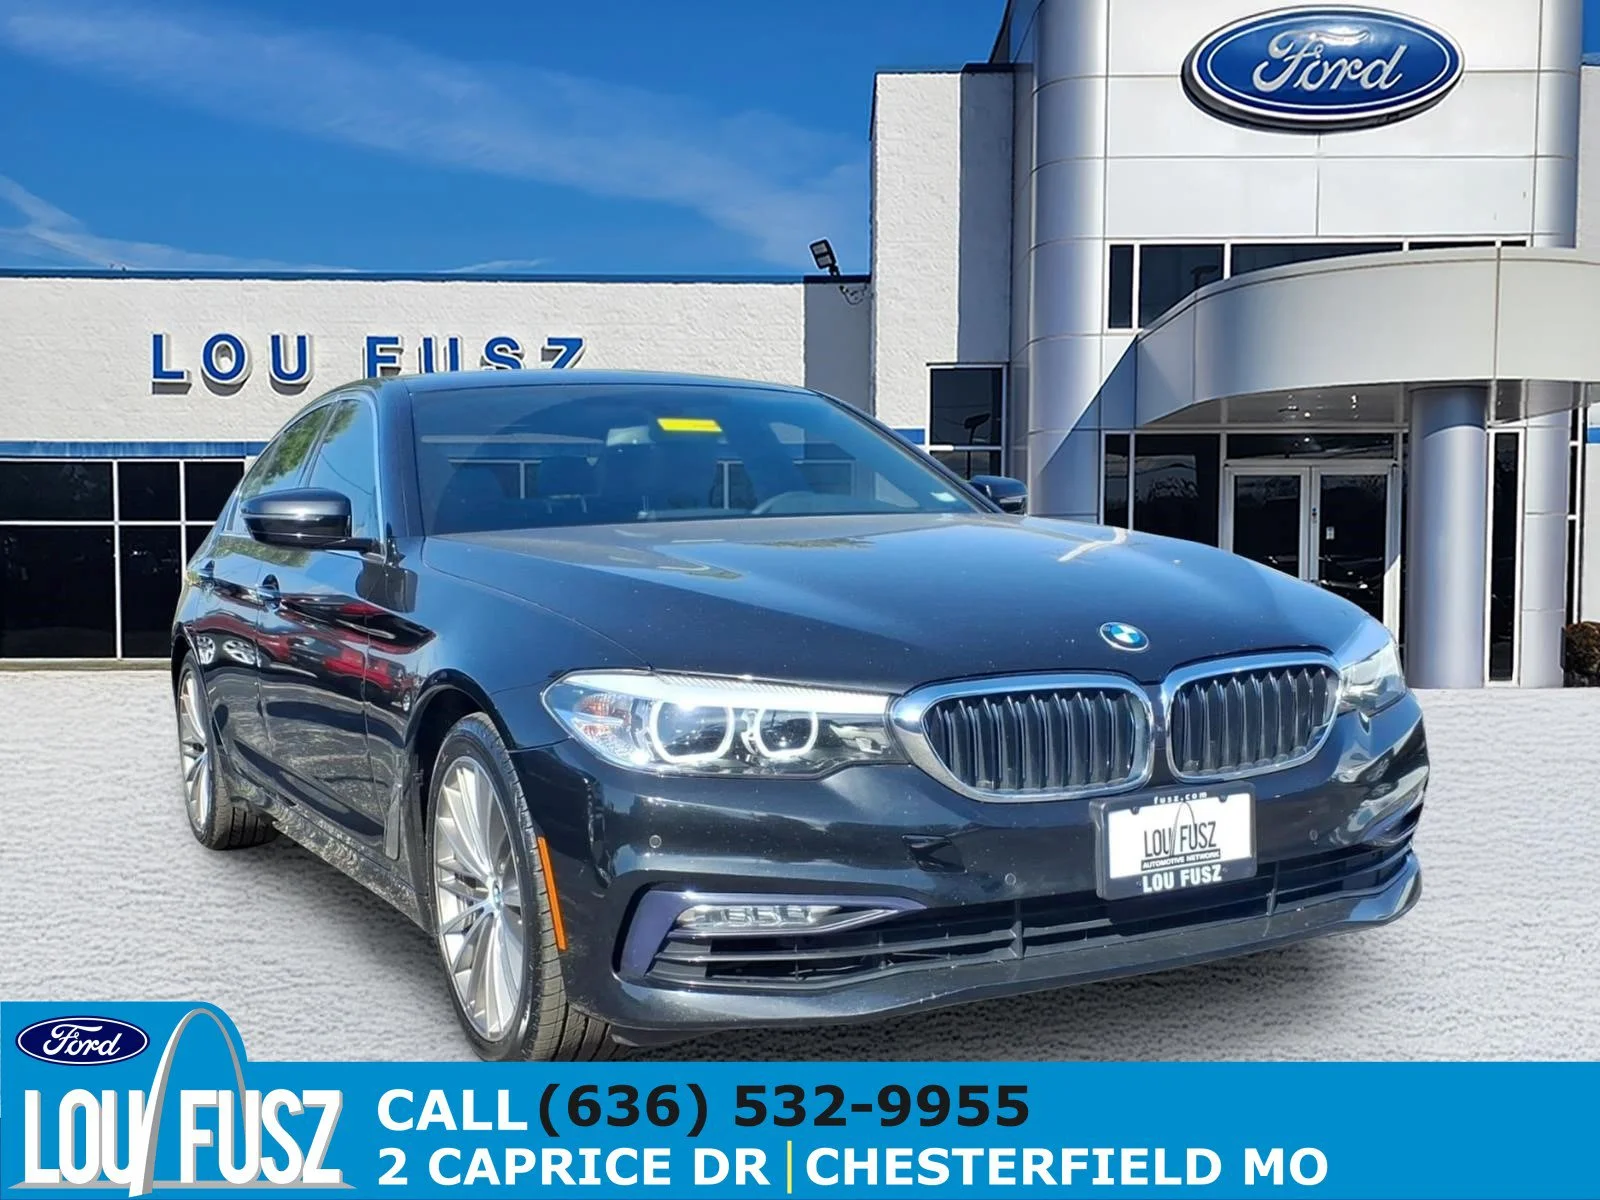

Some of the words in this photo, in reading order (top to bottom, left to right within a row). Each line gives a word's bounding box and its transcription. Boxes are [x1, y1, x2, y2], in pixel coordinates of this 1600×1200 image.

[1252, 29, 1408, 93] Ford
[151, 333, 310, 384] LOU
[363, 335, 587, 380] FUSZ
[1153, 791, 1208, 805] fusz.com
[1143, 826, 1173, 858] LOU
[1180, 821, 1217, 852] FUSZ
[1142, 856, 1185, 869] AUTOMOTIVE
[1142, 871, 1175, 894] LOU
[1180, 864, 1223, 888] FUSZ
